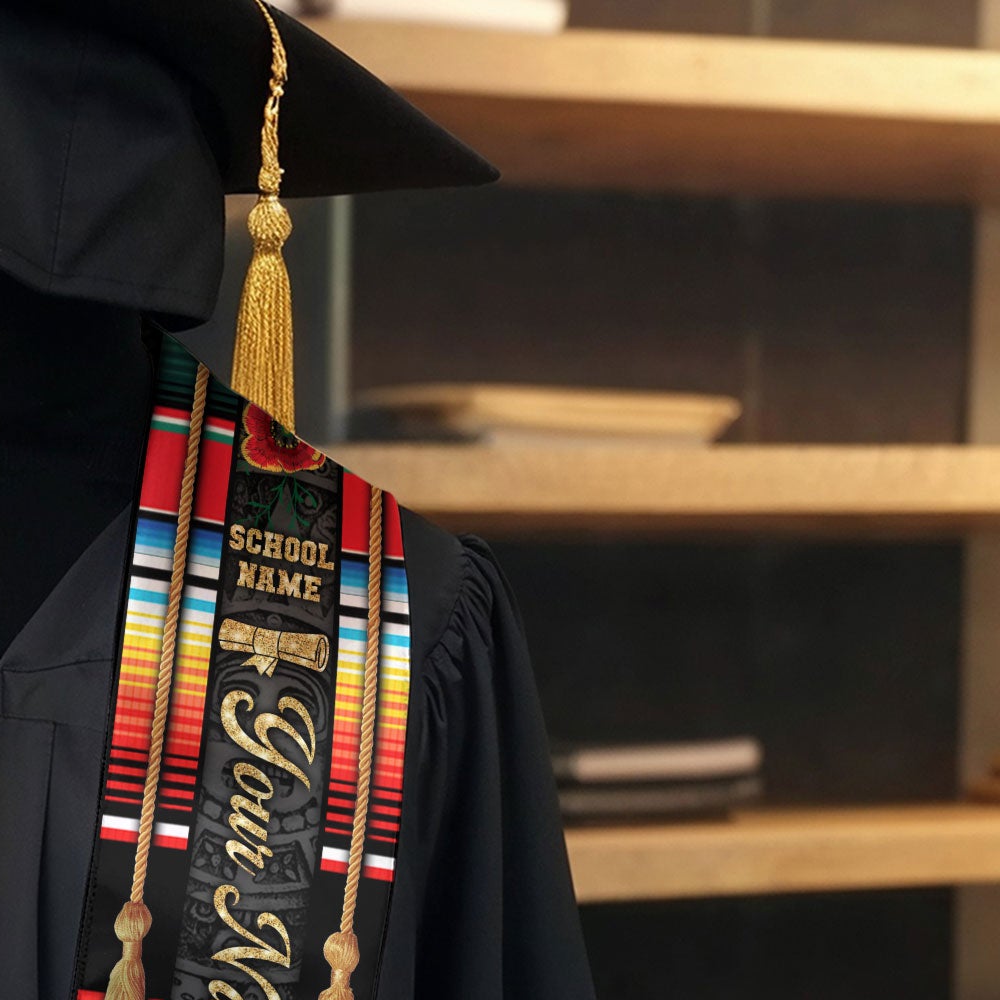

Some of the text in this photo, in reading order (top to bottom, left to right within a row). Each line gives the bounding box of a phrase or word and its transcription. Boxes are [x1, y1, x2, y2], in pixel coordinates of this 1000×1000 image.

[228, 523, 335, 571] SCHOOL
[236, 560, 322, 603] NAME
[220, 689, 316, 877] Your
